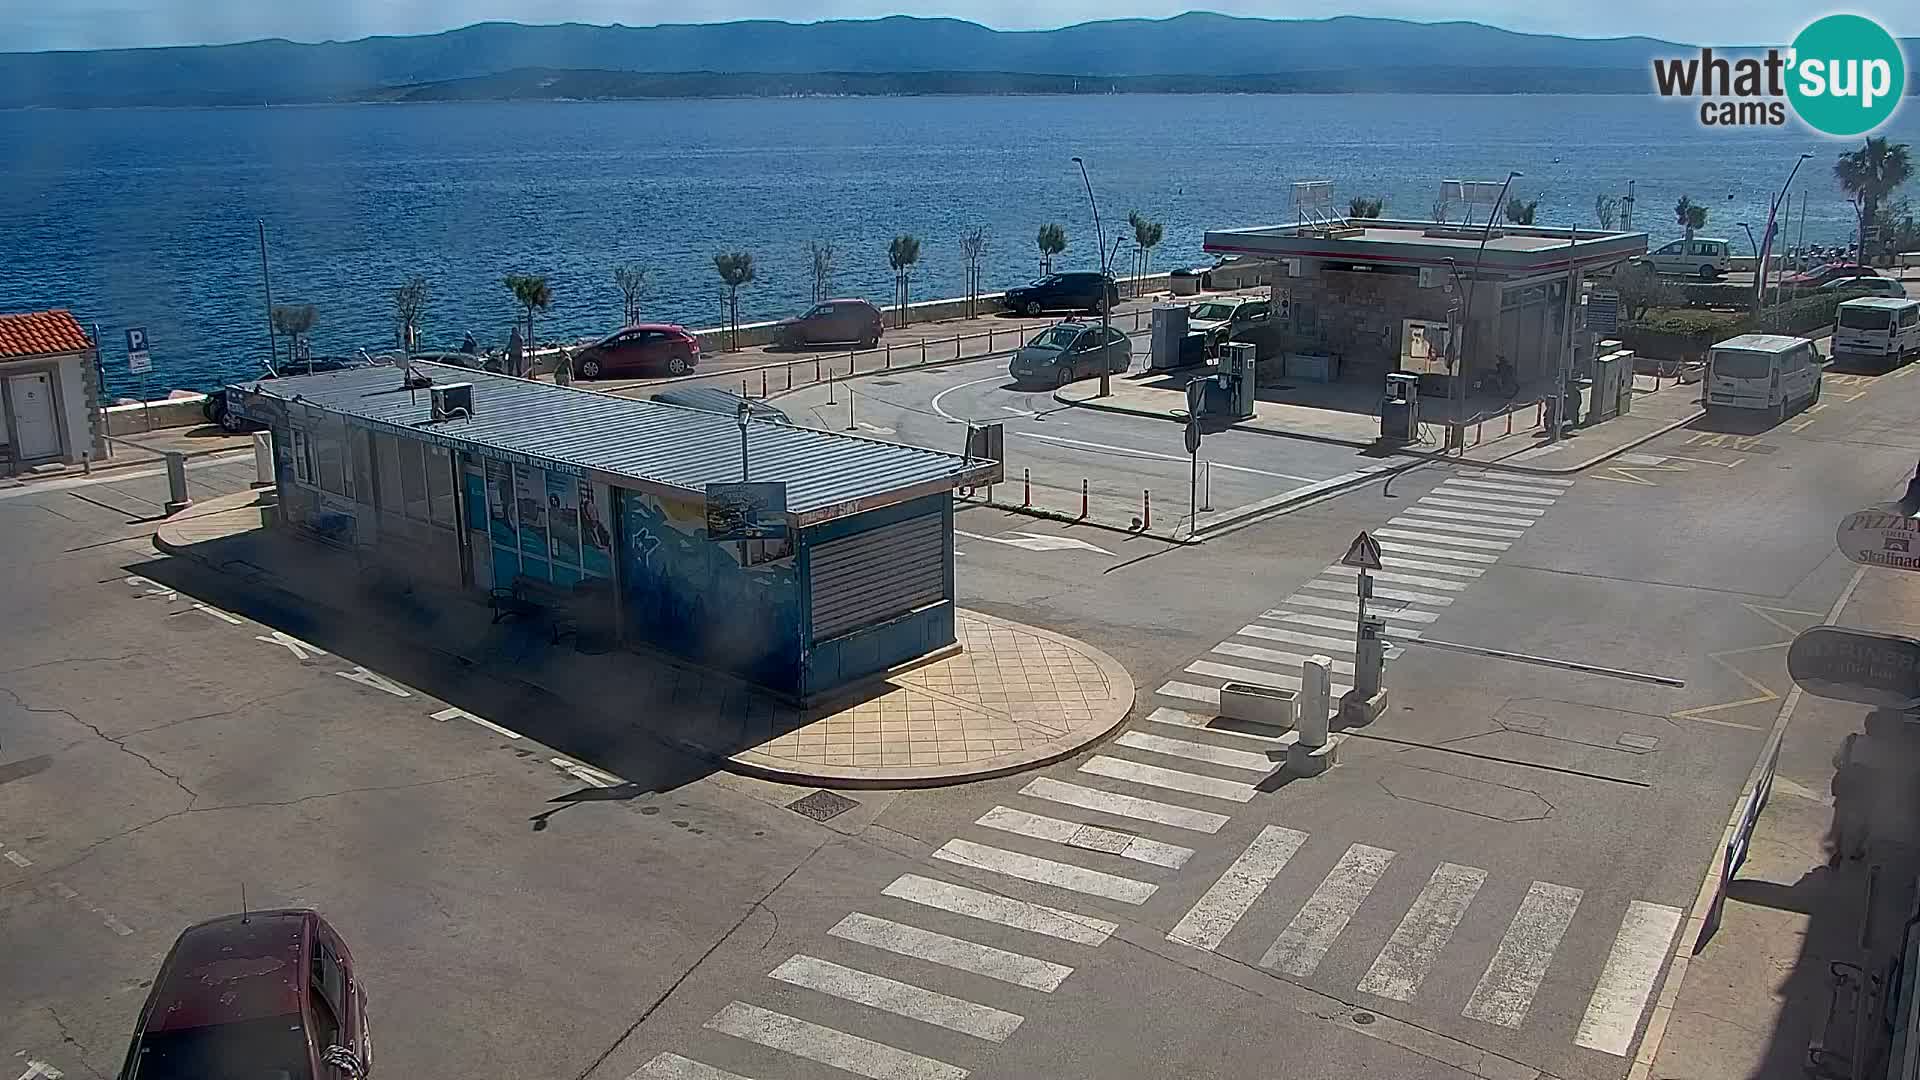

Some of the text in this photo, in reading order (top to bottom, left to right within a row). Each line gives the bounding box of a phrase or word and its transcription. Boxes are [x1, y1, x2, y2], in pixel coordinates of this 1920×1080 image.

[130, 330, 144, 349] P
[494, 449, 527, 465] STATION
[528, 456, 554, 471] TICKET
[555, 462, 583, 476] OFFICE
[1848, 514, 1920, 532] PIZZE
